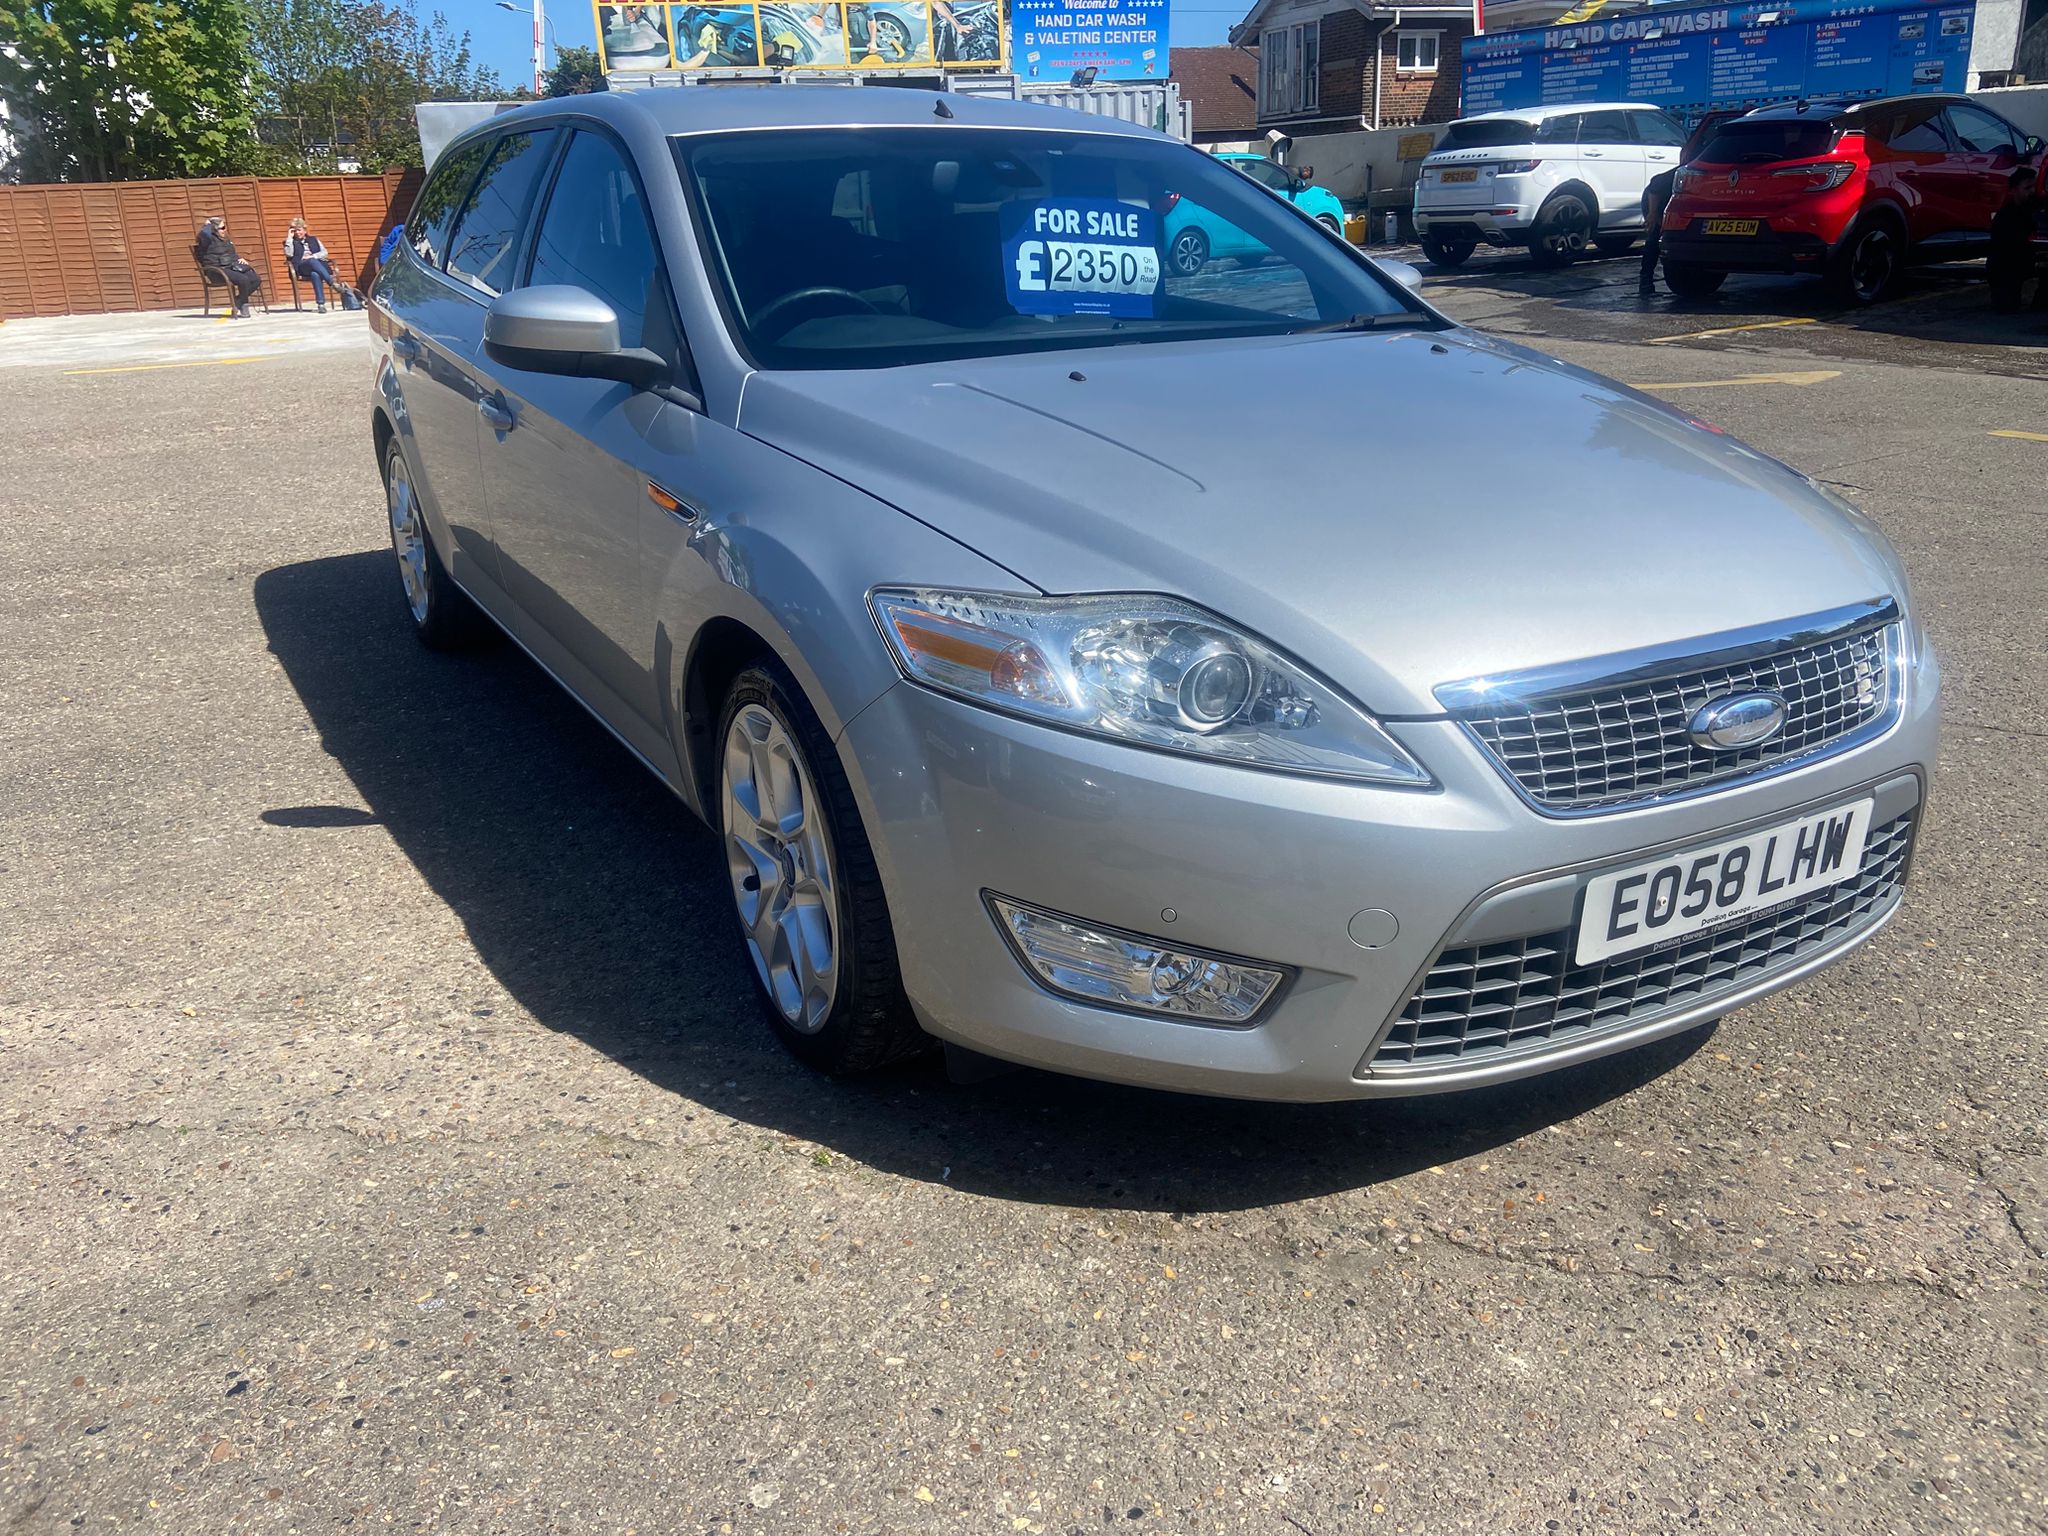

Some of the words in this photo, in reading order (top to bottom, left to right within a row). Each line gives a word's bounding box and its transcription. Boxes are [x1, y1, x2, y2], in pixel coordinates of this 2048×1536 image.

[1063, 0, 1106, 9] Welcome
[1035, 15, 1072, 27] HAND
[1076, 14, 1103, 27] CAR
[1107, 13, 1146, 25] WASH
[1545, 25, 1604, 49] HAND
[1658, 12, 1728, 35] WASH
[1025, 33, 1034, 45] &
[1038, 31, 1100, 44] VALETING
[1104, 30, 1157, 43] CENTER
[1035, 207, 1081, 234] FOR
[1086, 211, 1138, 237] SALE
[1708, 221, 1734, 233] AV25
[1735, 221, 1757, 233] EUM
[1143, 257, 1152, 265] On
[1144, 266, 1154, 274] the
[1140, 276, 1156, 284] Road
[1606, 846, 1751, 942] EO58
[1757, 811, 1855, 896] LHW
[1727, 905, 1751, 917] Garage
